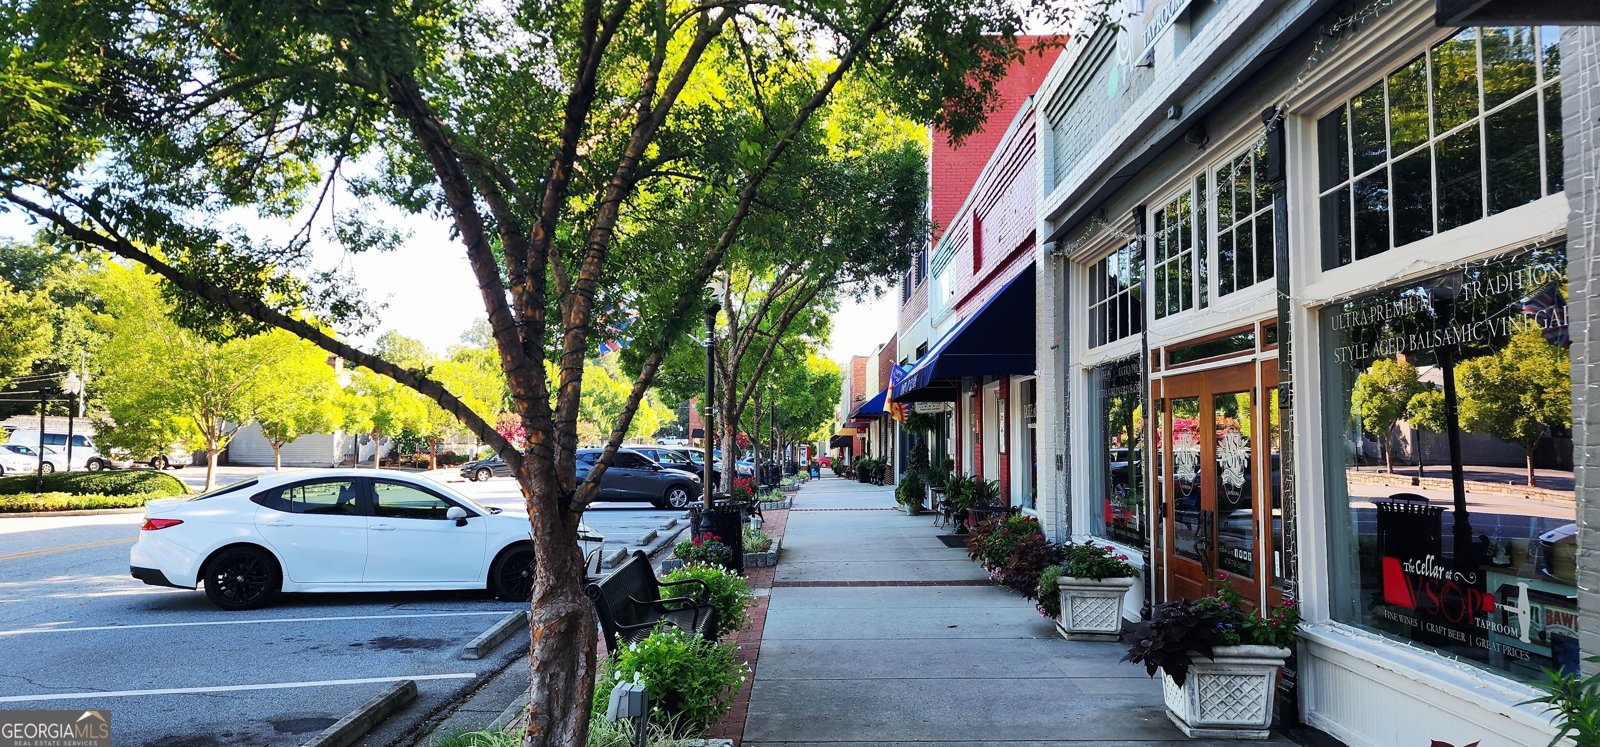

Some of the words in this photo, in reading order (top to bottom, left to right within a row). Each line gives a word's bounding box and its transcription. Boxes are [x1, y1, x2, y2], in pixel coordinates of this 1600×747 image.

[1331, 309, 1367, 331] ULTRA
[1369, 292, 1433, 323] PREMIUM
[1461, 262, 1562, 301] TRADITION
[1334, 342, 1369, 364] STYLE
[1373, 336, 1406, 358] AGED
[1409, 321, 1484, 352] BALSAMIC
[1403, 558, 1415, 573] The
[1415, 554, 1445, 580] Cellar
[1445, 569, 1453, 580] at
[1405, 573, 1482, 625] VSOP
[1384, 609, 1398, 622] FINE
[1398, 614, 1418, 627] WINES
[1426, 622, 1447, 636] CRAFT
[1448, 628, 1466, 642] BEER
[1475, 637, 1501, 653] GREAT
[1502, 644, 1530, 660] PRICES
[1475, 617, 1520, 638] TAPROOM
